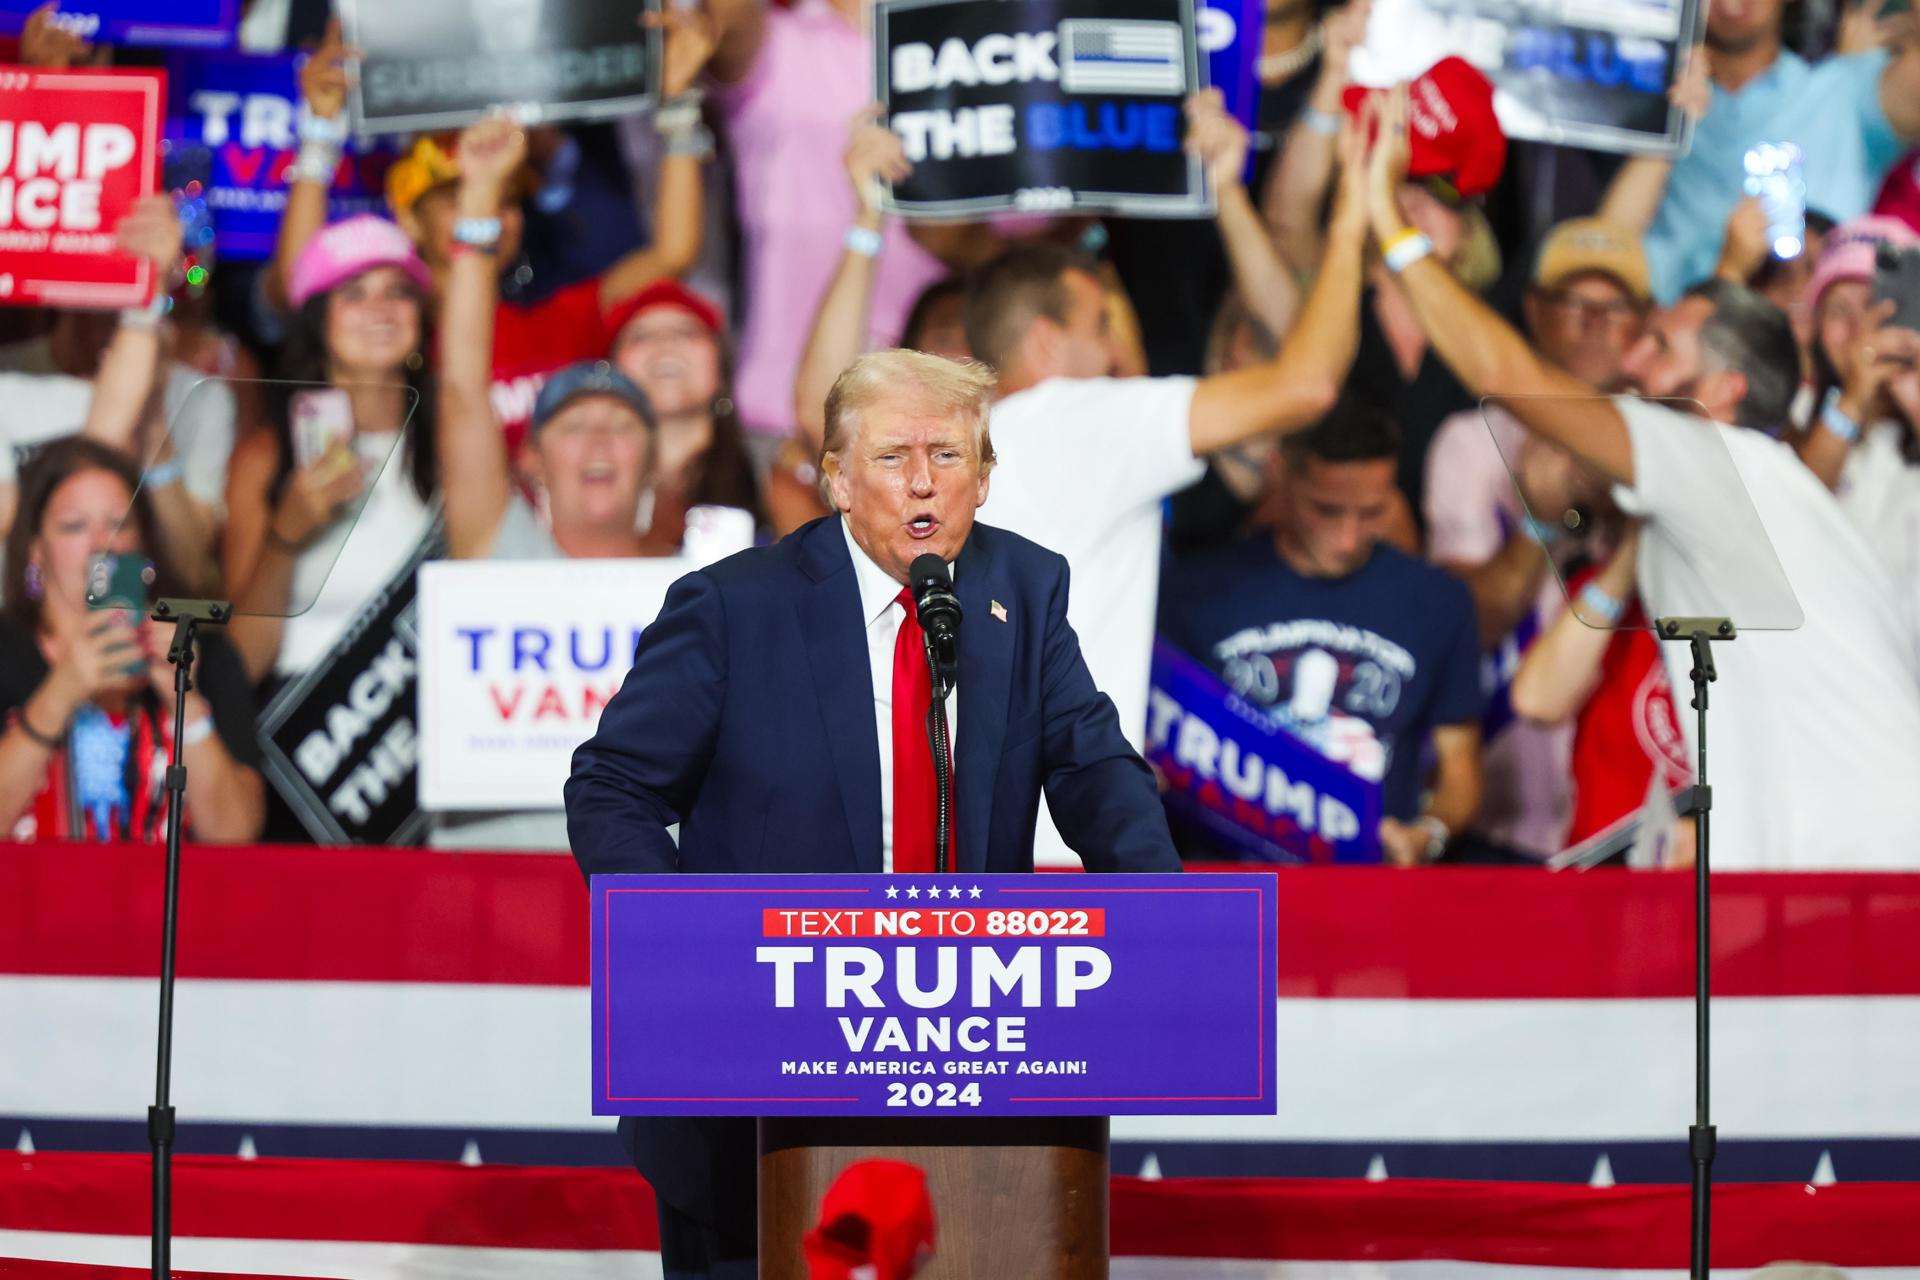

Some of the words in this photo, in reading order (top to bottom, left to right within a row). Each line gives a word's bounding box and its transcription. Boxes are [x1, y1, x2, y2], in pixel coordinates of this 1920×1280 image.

[892, 31, 1057, 92] BACK
[0, 120, 136, 182] MP
[891, 104, 1016, 162] THE
[1026, 101, 1180, 154] BLUE
[0, 176, 102, 231] CE
[294, 636, 416, 788] BACK
[328, 714, 417, 826] THE
[1150, 685, 1361, 843] TRUMP
[780, 911, 864, 935] TEXT
[874, 911, 921, 935] NC
[931, 911, 976, 935] TO
[986, 911, 1089, 935] 88022
[756, 946, 1112, 1009] TRUMP
[838, 1016, 1026, 1052] VANCE
[781, 1061, 838, 1075] MAKE
[844, 1061, 937, 1075] AMERICA
[943, 1061, 1009, 1075] GREAT
[1016, 1061, 1088, 1075] AGAIN!
[887, 1082, 982, 1107] 2024
